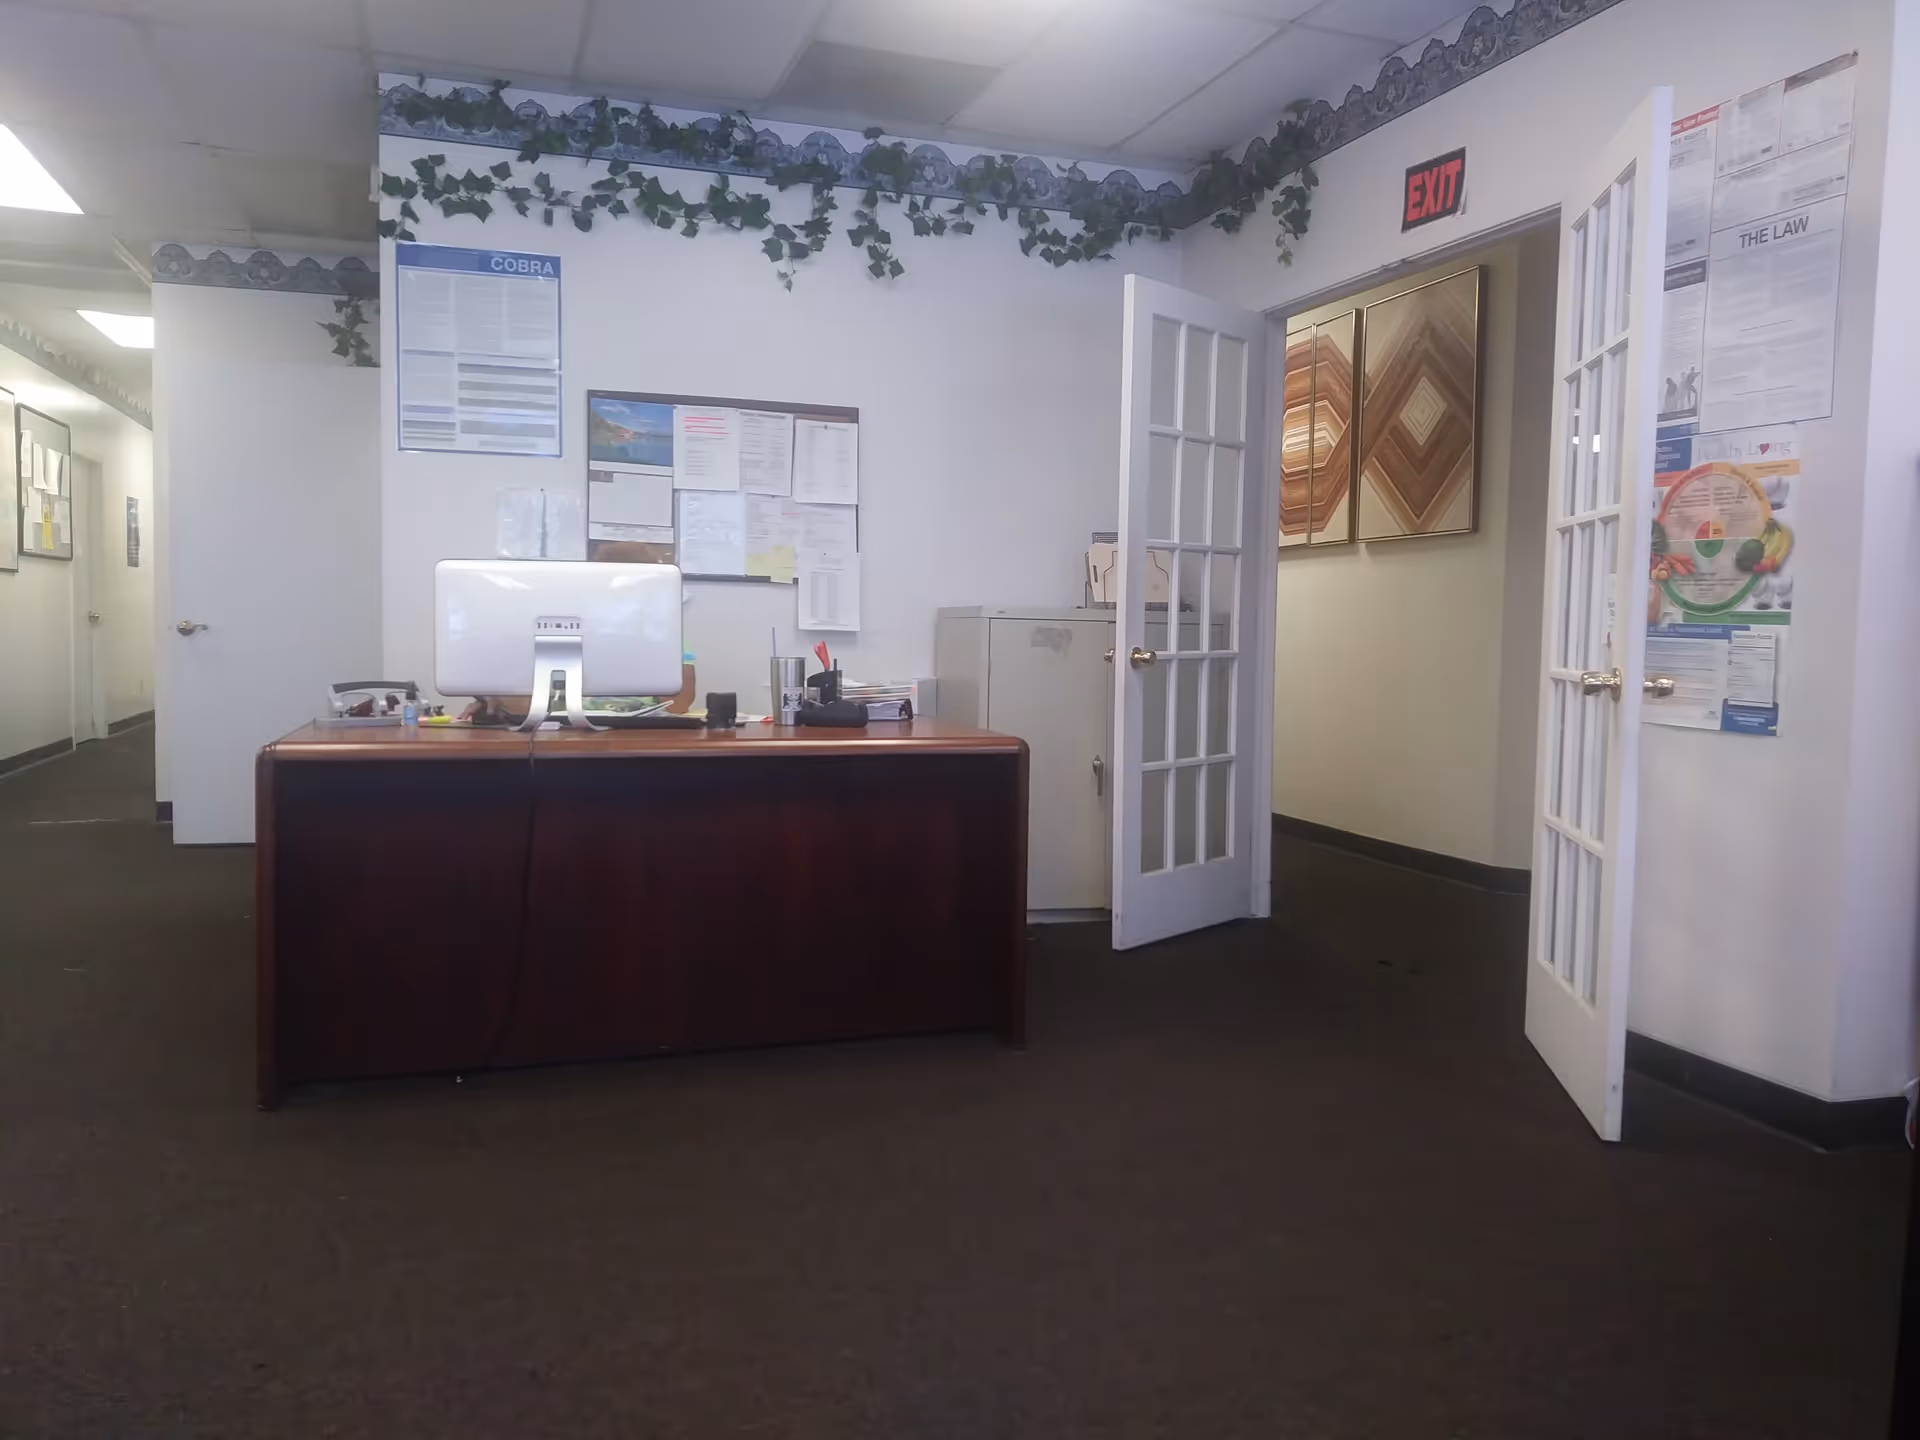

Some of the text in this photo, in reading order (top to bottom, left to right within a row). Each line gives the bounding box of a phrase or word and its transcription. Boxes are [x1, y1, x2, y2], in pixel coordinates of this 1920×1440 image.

[1407, 159, 1462, 221] EXIT
[1738, 215, 1809, 249] THE LAW
[491, 257, 554, 275] COBRA
